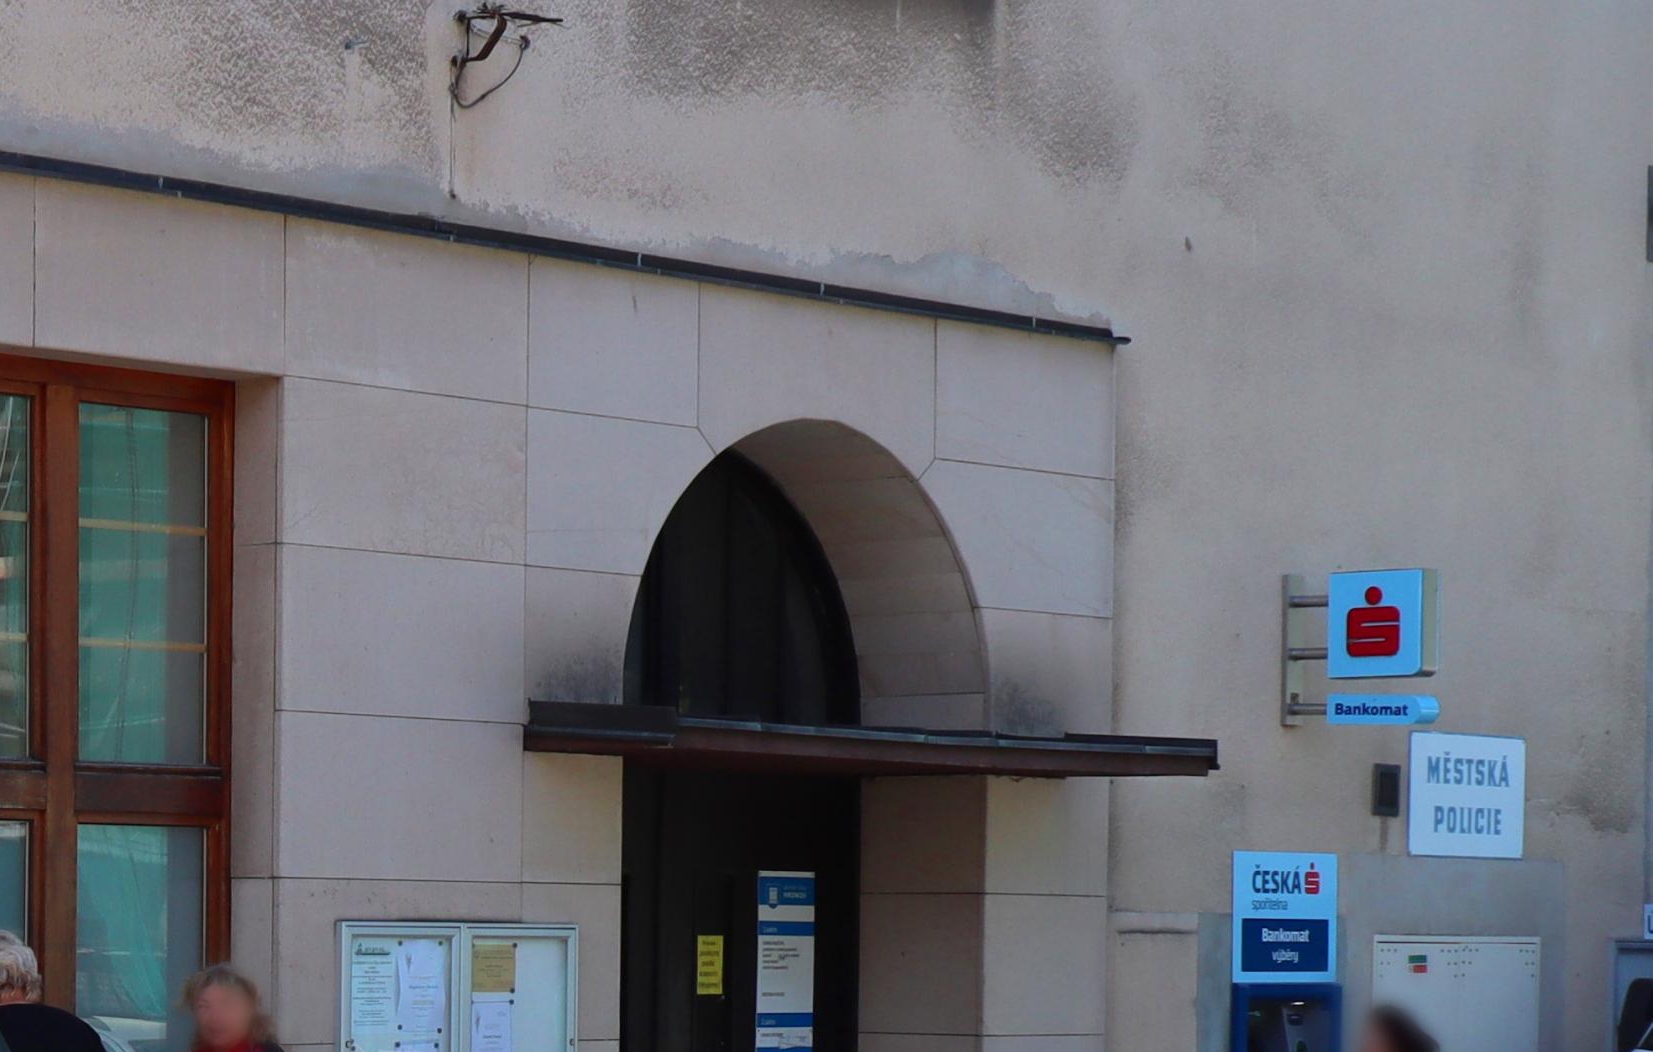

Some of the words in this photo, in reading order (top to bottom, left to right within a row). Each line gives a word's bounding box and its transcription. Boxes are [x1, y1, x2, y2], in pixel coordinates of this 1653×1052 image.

[1334, 701, 1409, 717] Bankomat
[1426, 751, 1510, 788] MĚSTSKÁ
[1432, 805, 1502, 836] POLICIE
[1251, 864, 1302, 895] ČESKÁ
[1251, 897, 1289, 912] spořitelna
[1261, 927, 1310, 943] Bankomat
[1271, 948, 1299, 964] výběry
